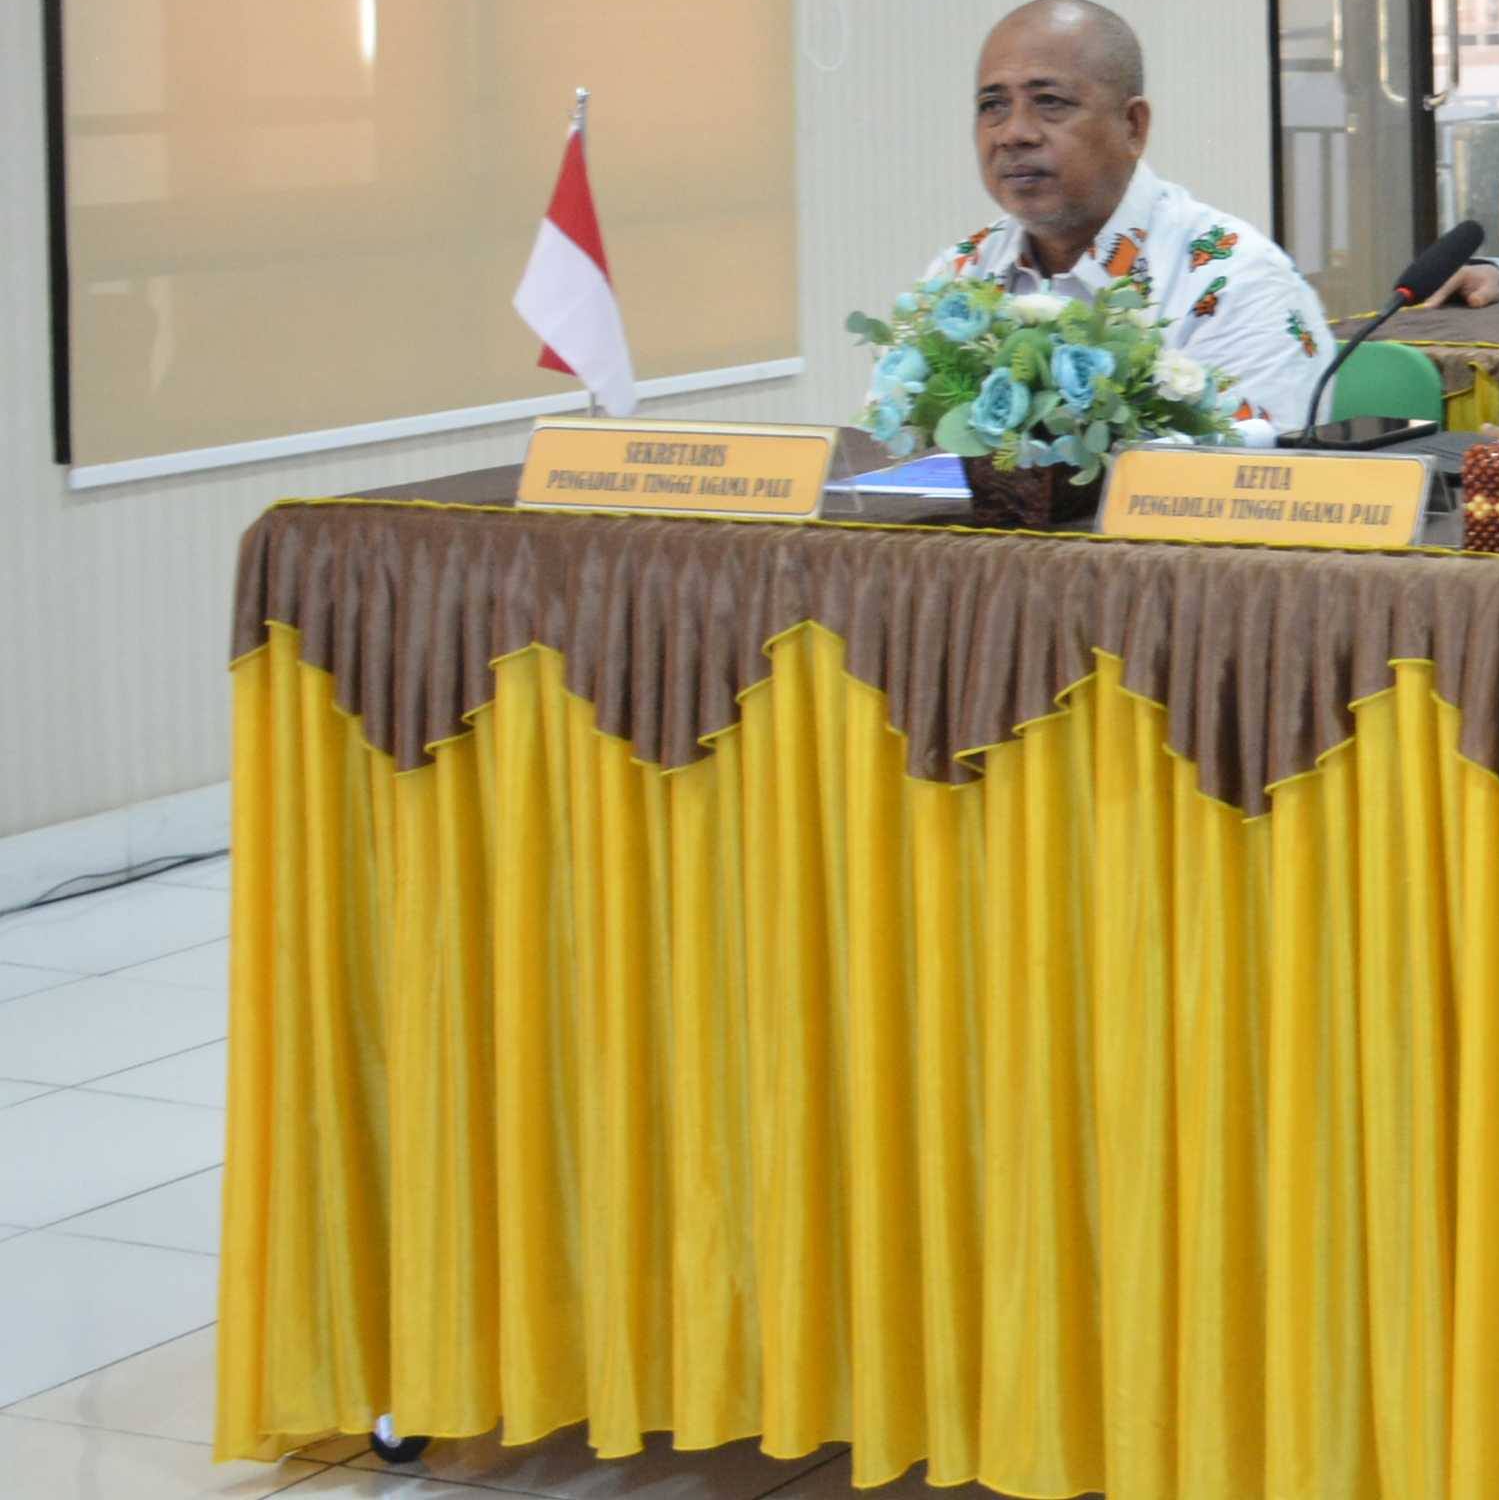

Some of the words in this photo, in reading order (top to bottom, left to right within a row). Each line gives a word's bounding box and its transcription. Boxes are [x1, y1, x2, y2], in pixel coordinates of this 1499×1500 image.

[624, 441, 728, 467] SEKRETARIS
[546, 469, 638, 493] PENGADILAN
[641, 473, 694, 495] TINGGI
[699, 475, 748, 497] AGAMA
[1234, 465, 1293, 491] KETUA
[1127, 495, 1226, 519] PENGADILAN
[1229, 498, 1285, 521] TINGGI
[1288, 501, 1345, 524] AGAMA
[1348, 504, 1393, 526] PALU
